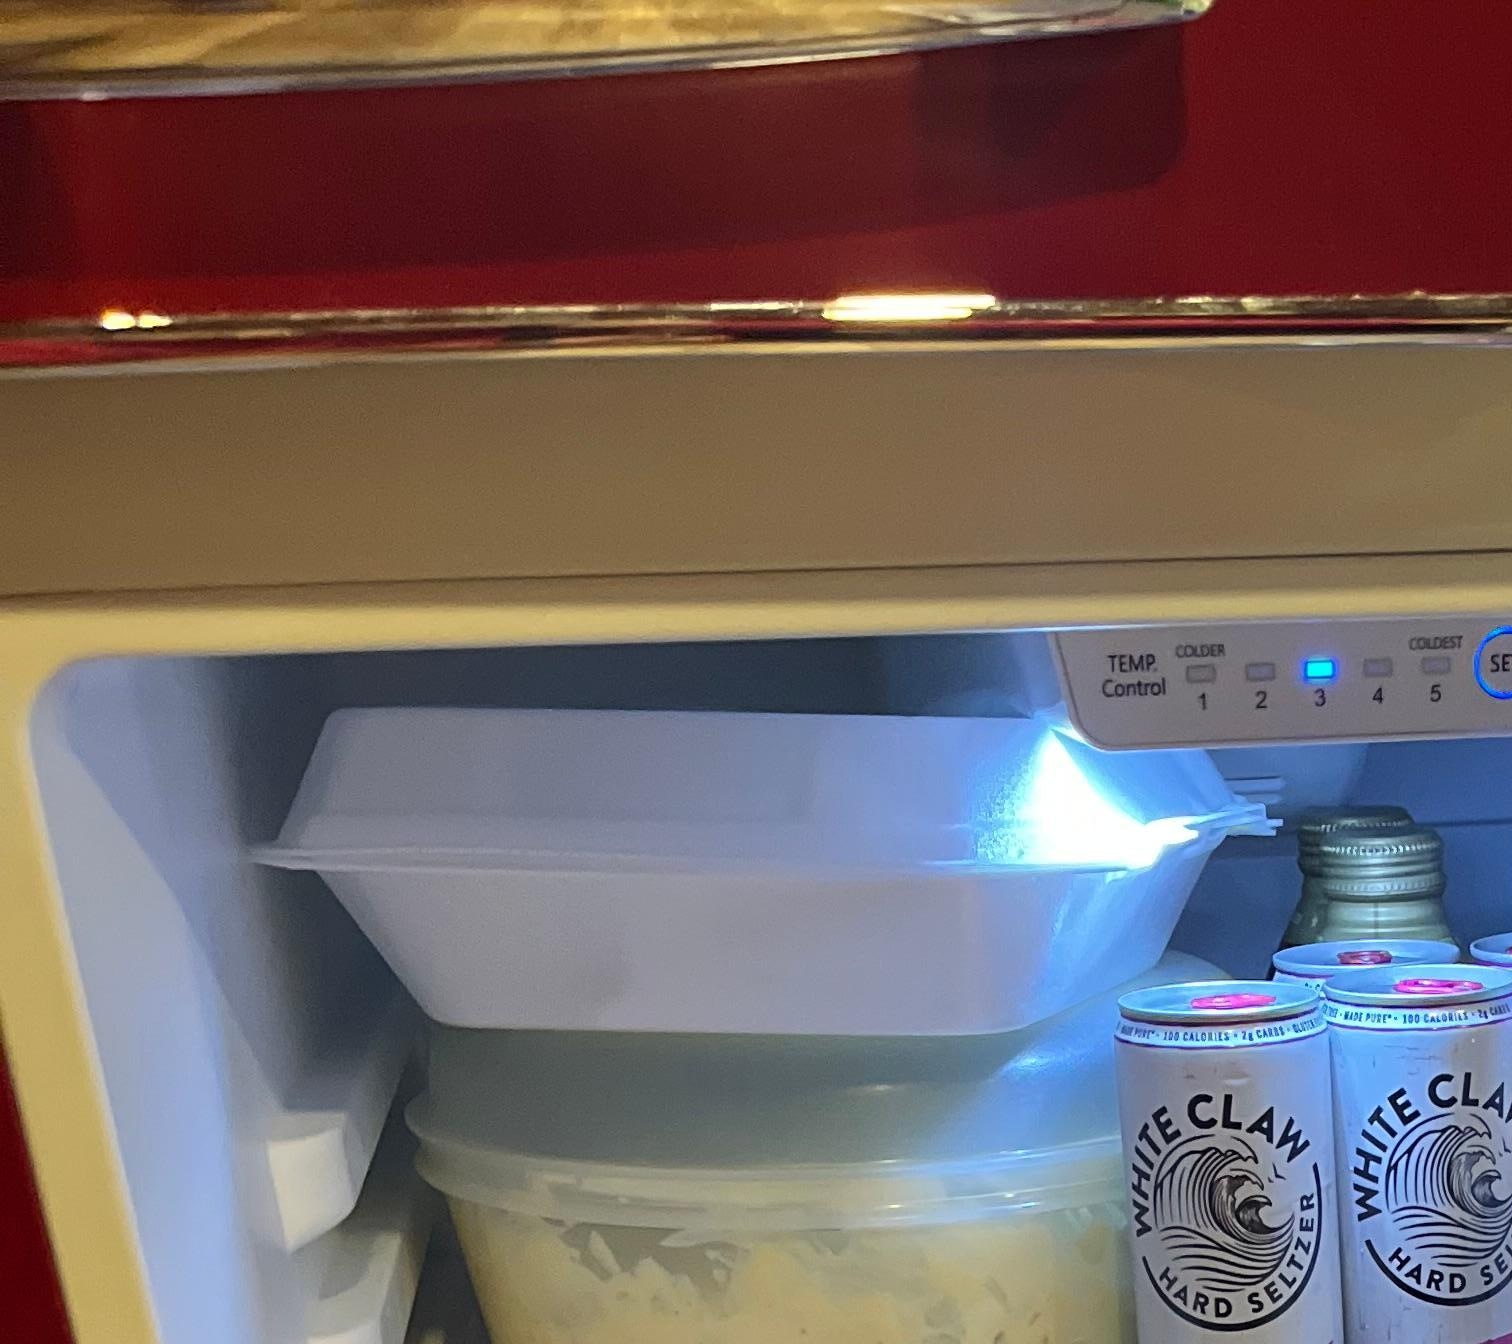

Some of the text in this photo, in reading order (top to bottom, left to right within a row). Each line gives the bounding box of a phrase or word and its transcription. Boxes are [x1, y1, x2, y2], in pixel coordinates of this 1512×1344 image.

[1175, 643, 1226, 659] COLDER
[1408, 634, 1464, 650] COLDEST
[1107, 653, 1158, 674] TEMP.
[1101, 677, 1166, 699] Control
[1197, 684, 1442, 711] 1 2 3 4 5
[1182, 1030, 1230, 1043] CALORIES
[1131, 1093, 1312, 1238] WHITE CLAW
[1352, 1086, 1422, 1223] WHITE
[1158, 1192, 1316, 1319] HARD SELTZER
[1388, 1247, 1467, 1294] HARD
